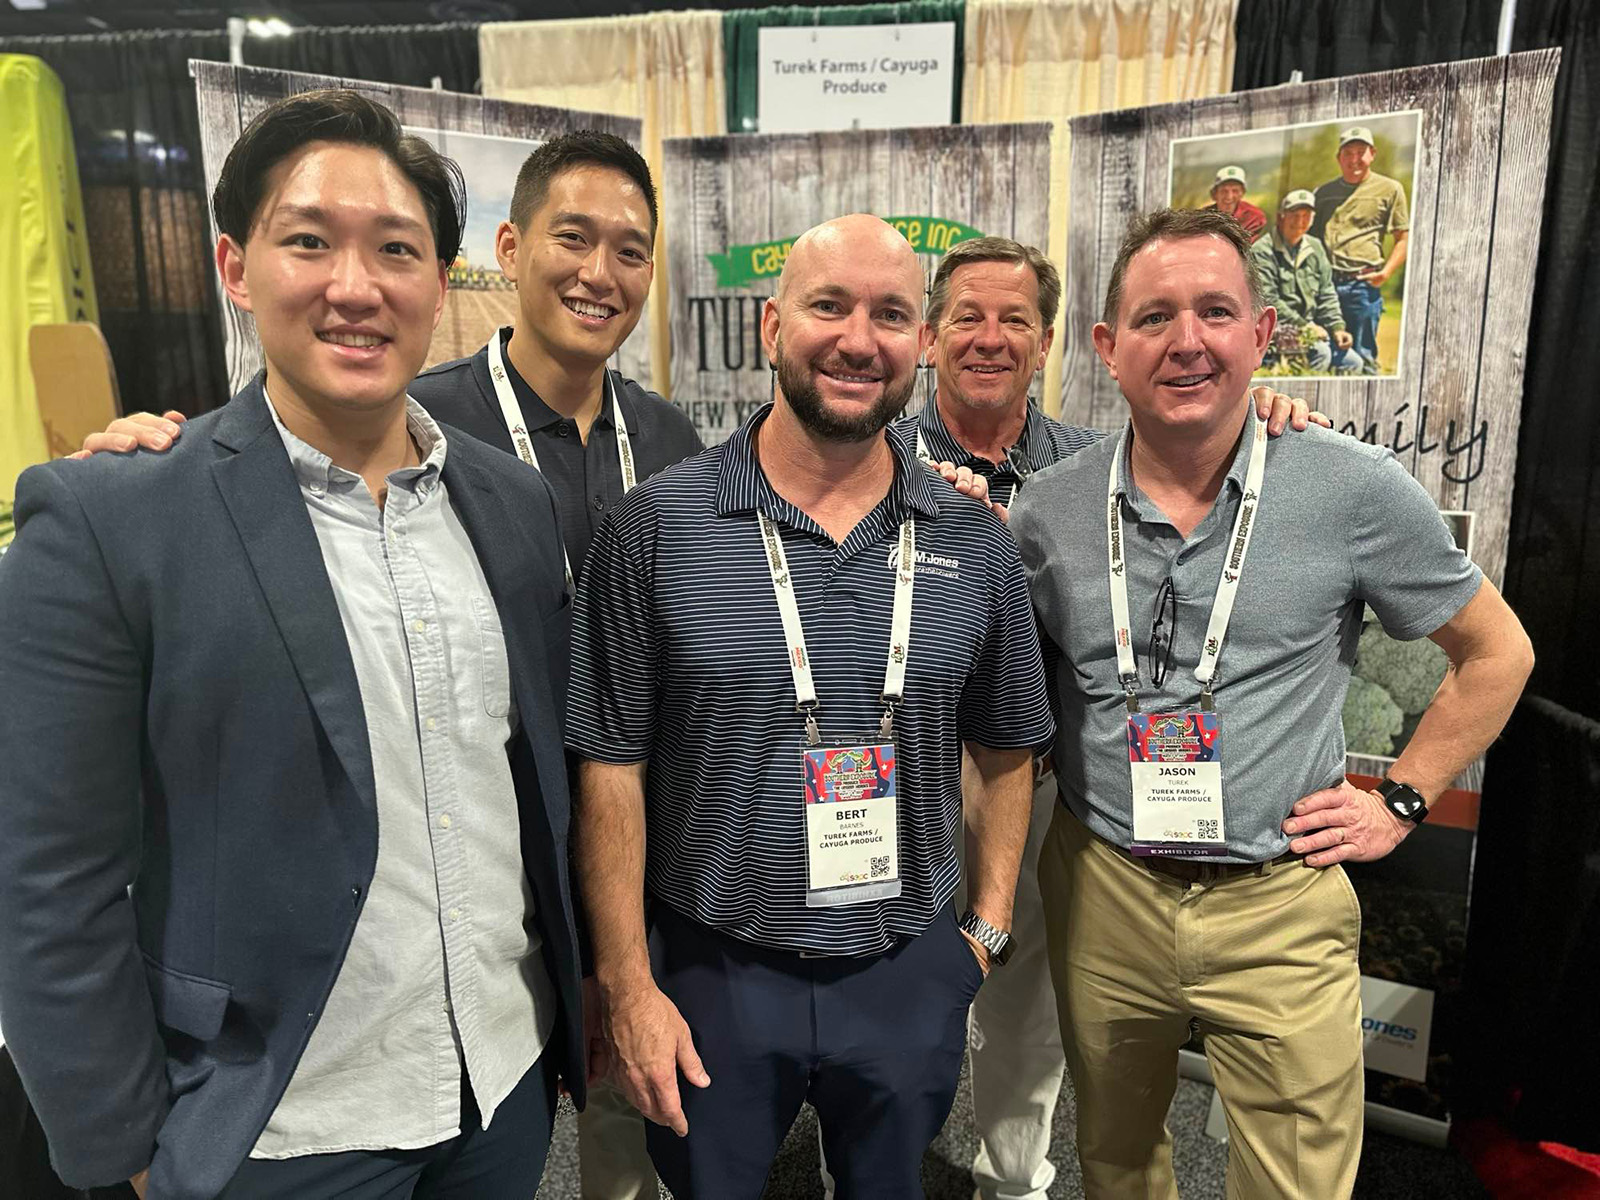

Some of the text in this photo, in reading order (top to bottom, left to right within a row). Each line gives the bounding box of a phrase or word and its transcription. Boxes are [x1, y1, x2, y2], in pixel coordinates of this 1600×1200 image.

[773, 58, 939, 75] Turek Farms / Cayuga
[823, 79, 887, 94] Produce
[1158, 768, 1196, 776] JASON
[836, 808, 867, 821] BERT
[840, 822, 864, 830] BARNES
[824, 832, 847, 840] TUREK
[849, 830, 873, 839] FARMS
[819, 835, 883, 849] CAYUGA PRODUCE
